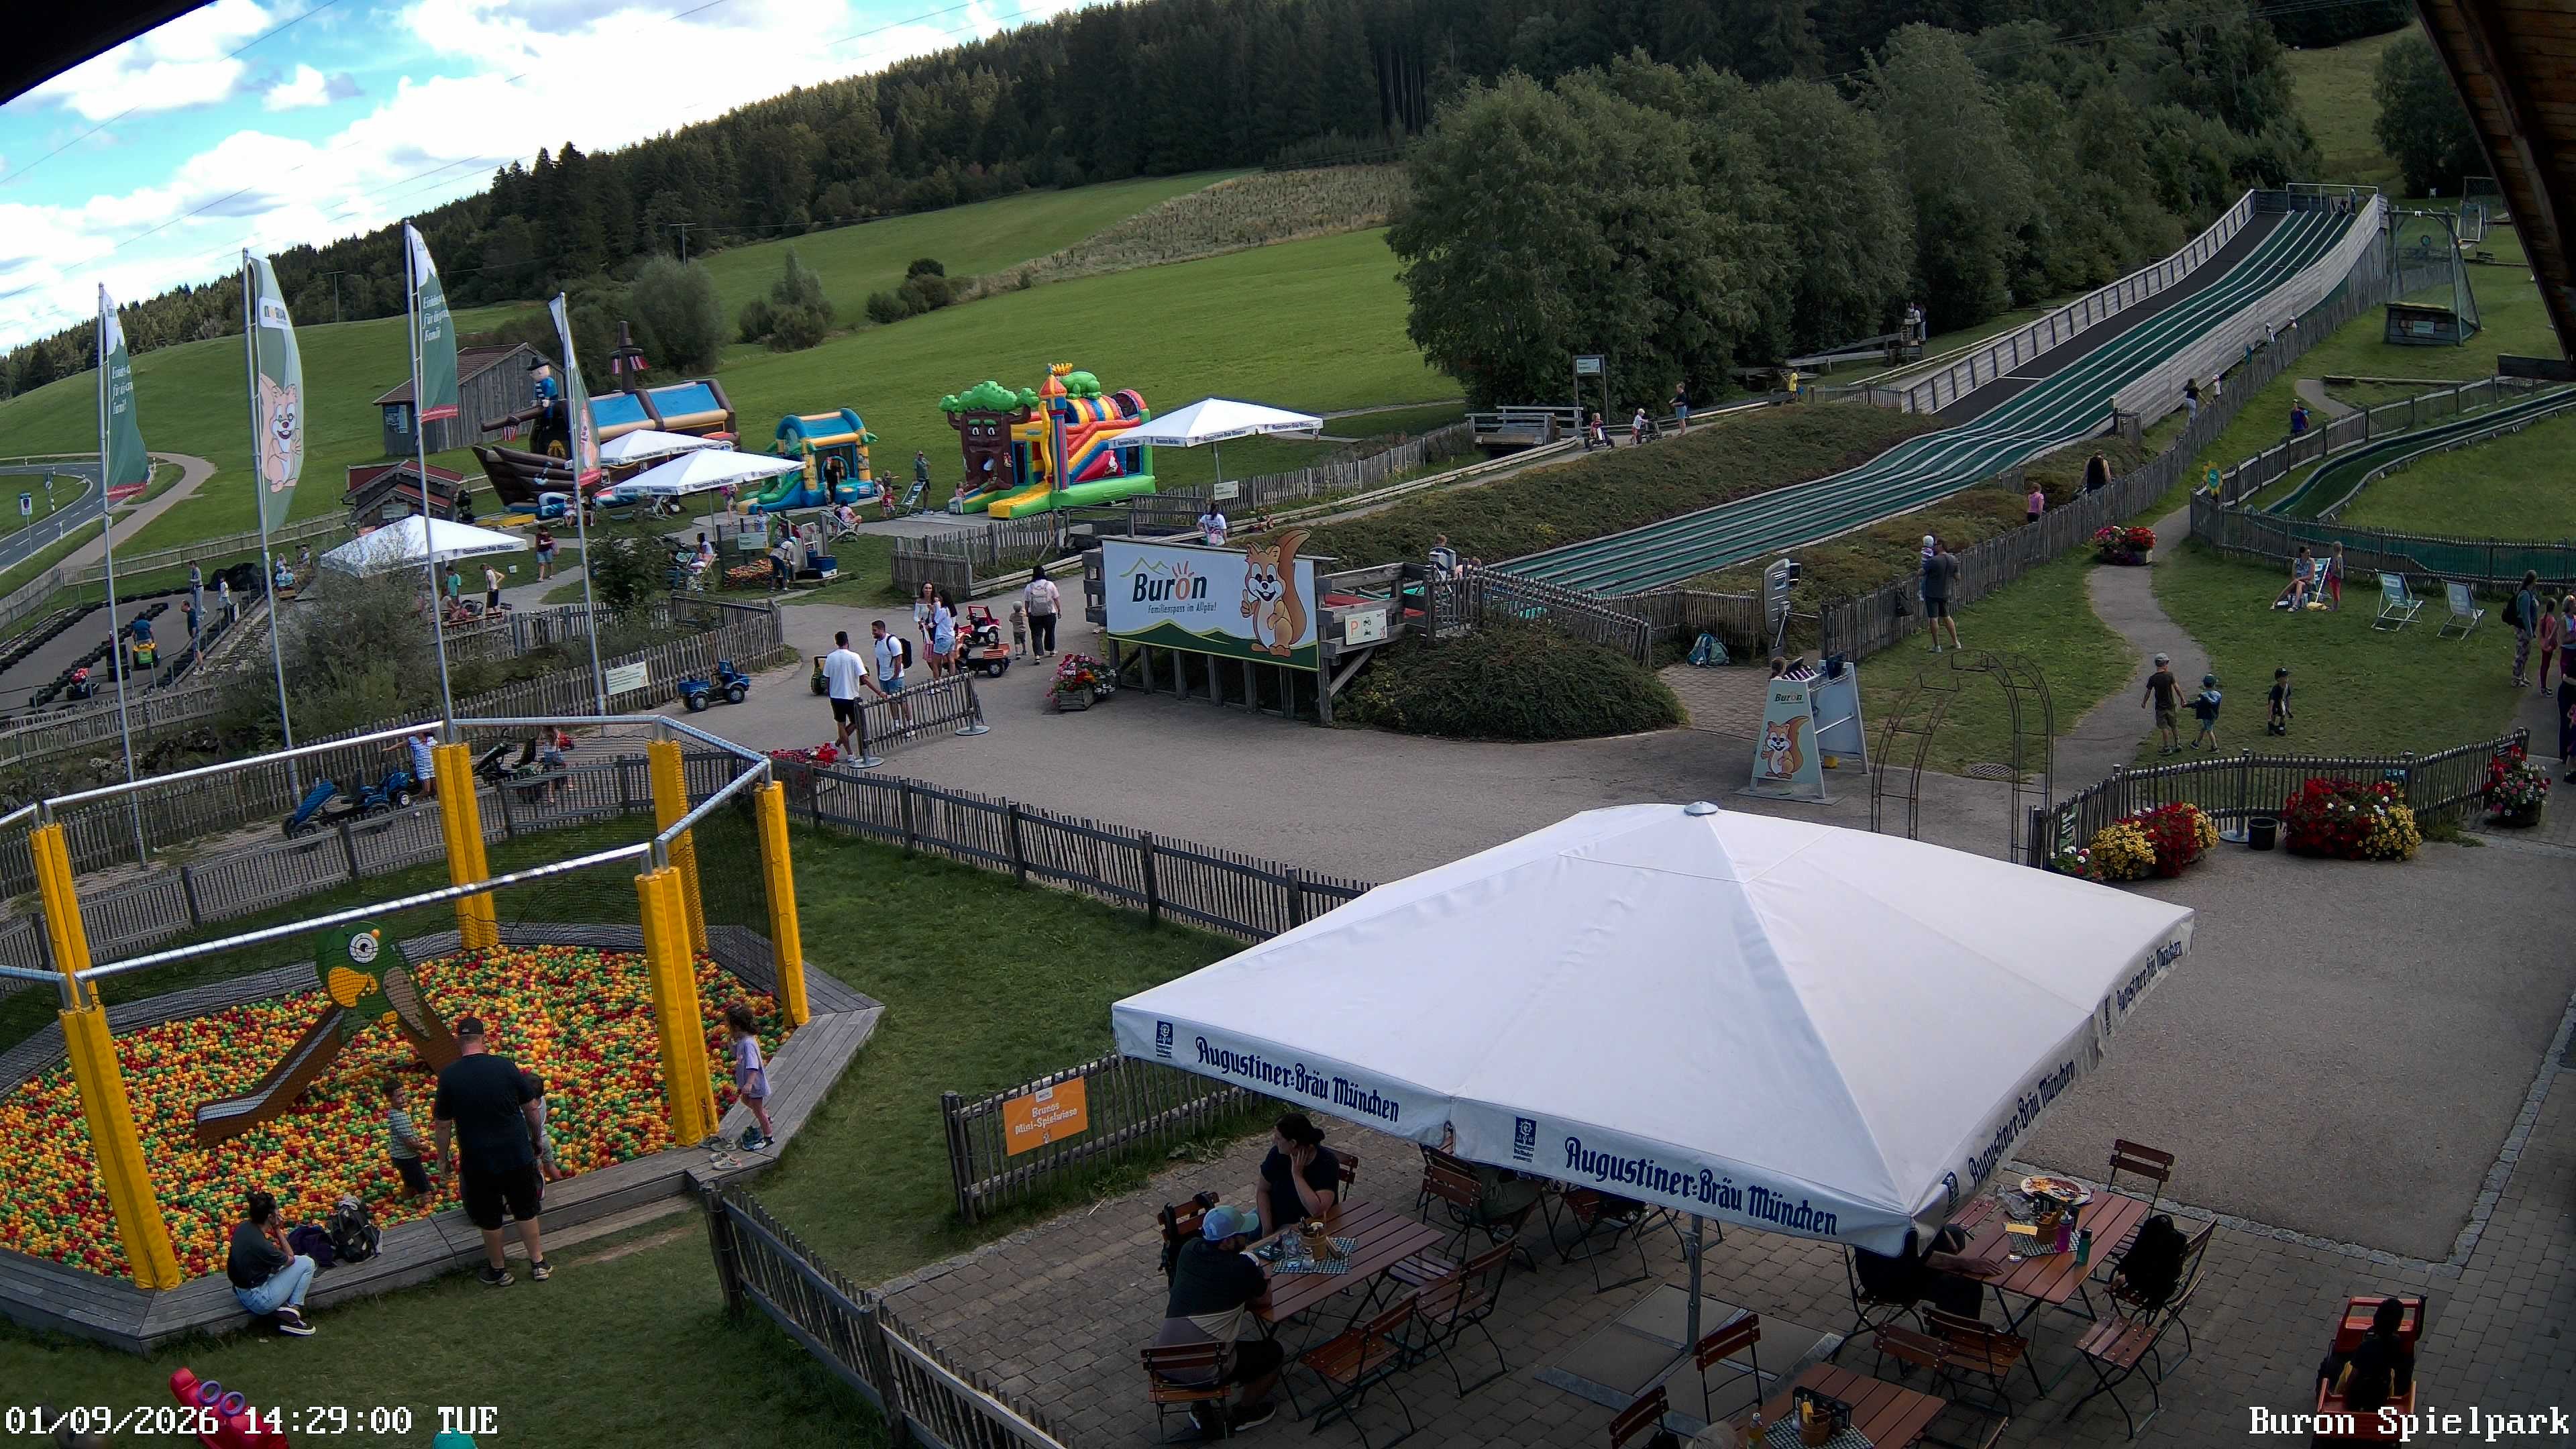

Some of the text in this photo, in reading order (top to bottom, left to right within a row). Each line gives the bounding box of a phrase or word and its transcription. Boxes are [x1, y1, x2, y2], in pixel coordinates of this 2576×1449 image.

[1132, 573, 1208, 602] Buron
[1350, 621, 1358, 637] P
[1332, 1076, 1399, 1123] München
[2038, 1059, 2076, 1108] München
[1748, 1185, 1838, 1236] München
